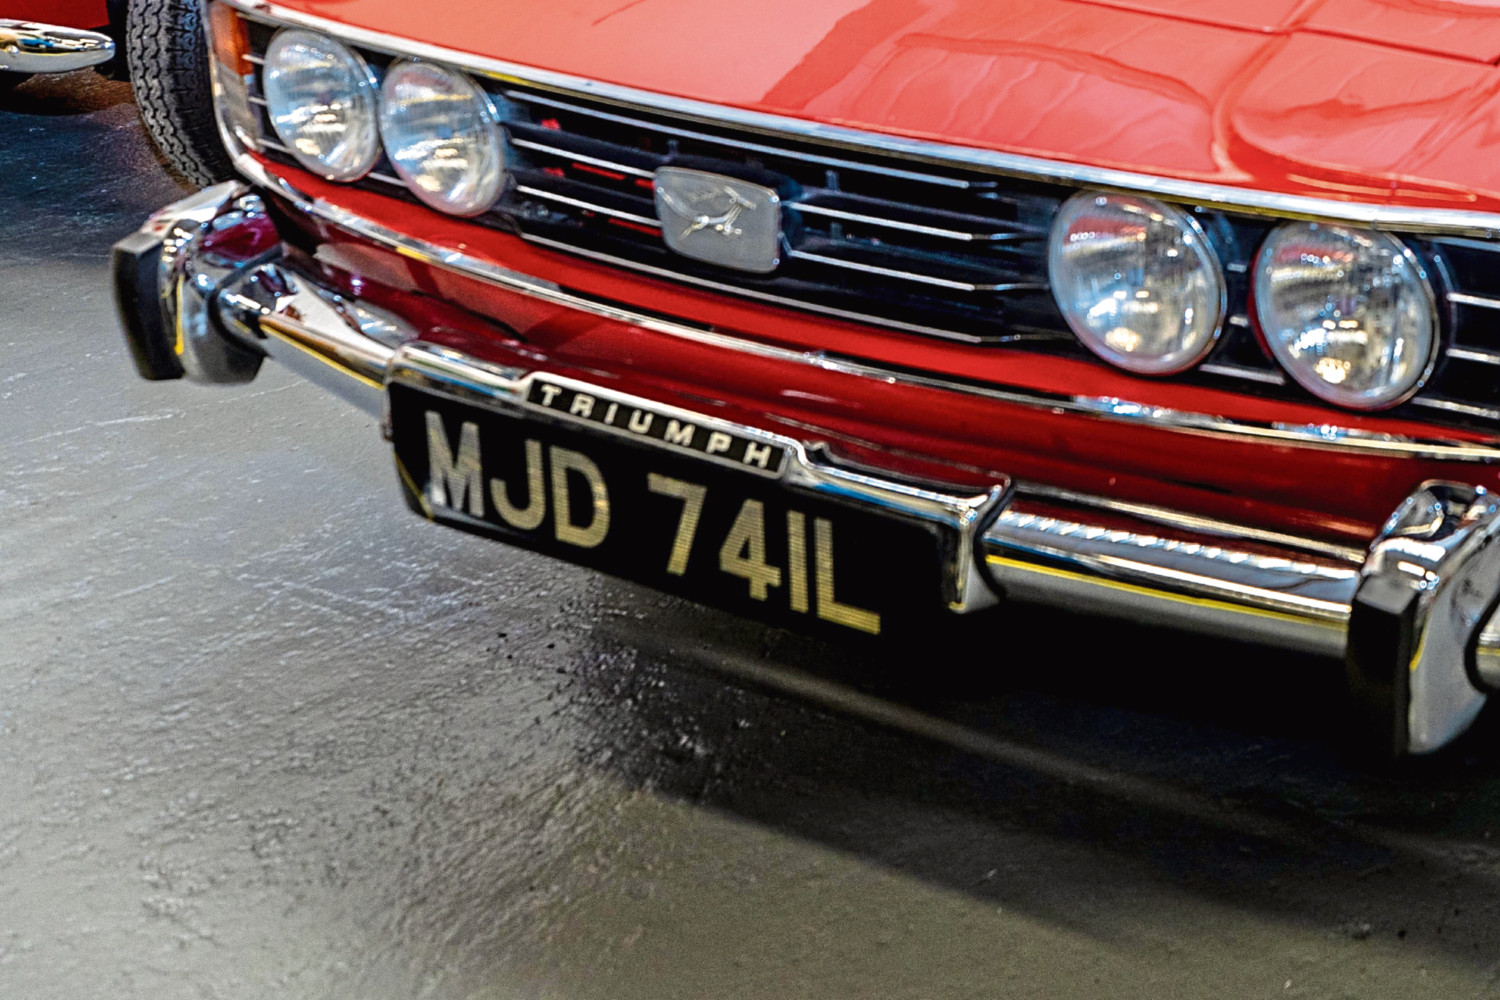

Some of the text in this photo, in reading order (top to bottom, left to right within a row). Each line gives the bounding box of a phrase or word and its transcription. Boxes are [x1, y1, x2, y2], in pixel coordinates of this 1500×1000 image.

[540, 383, 773, 469] TRIUMPH
[425, 409, 881, 635] MJD 741L
